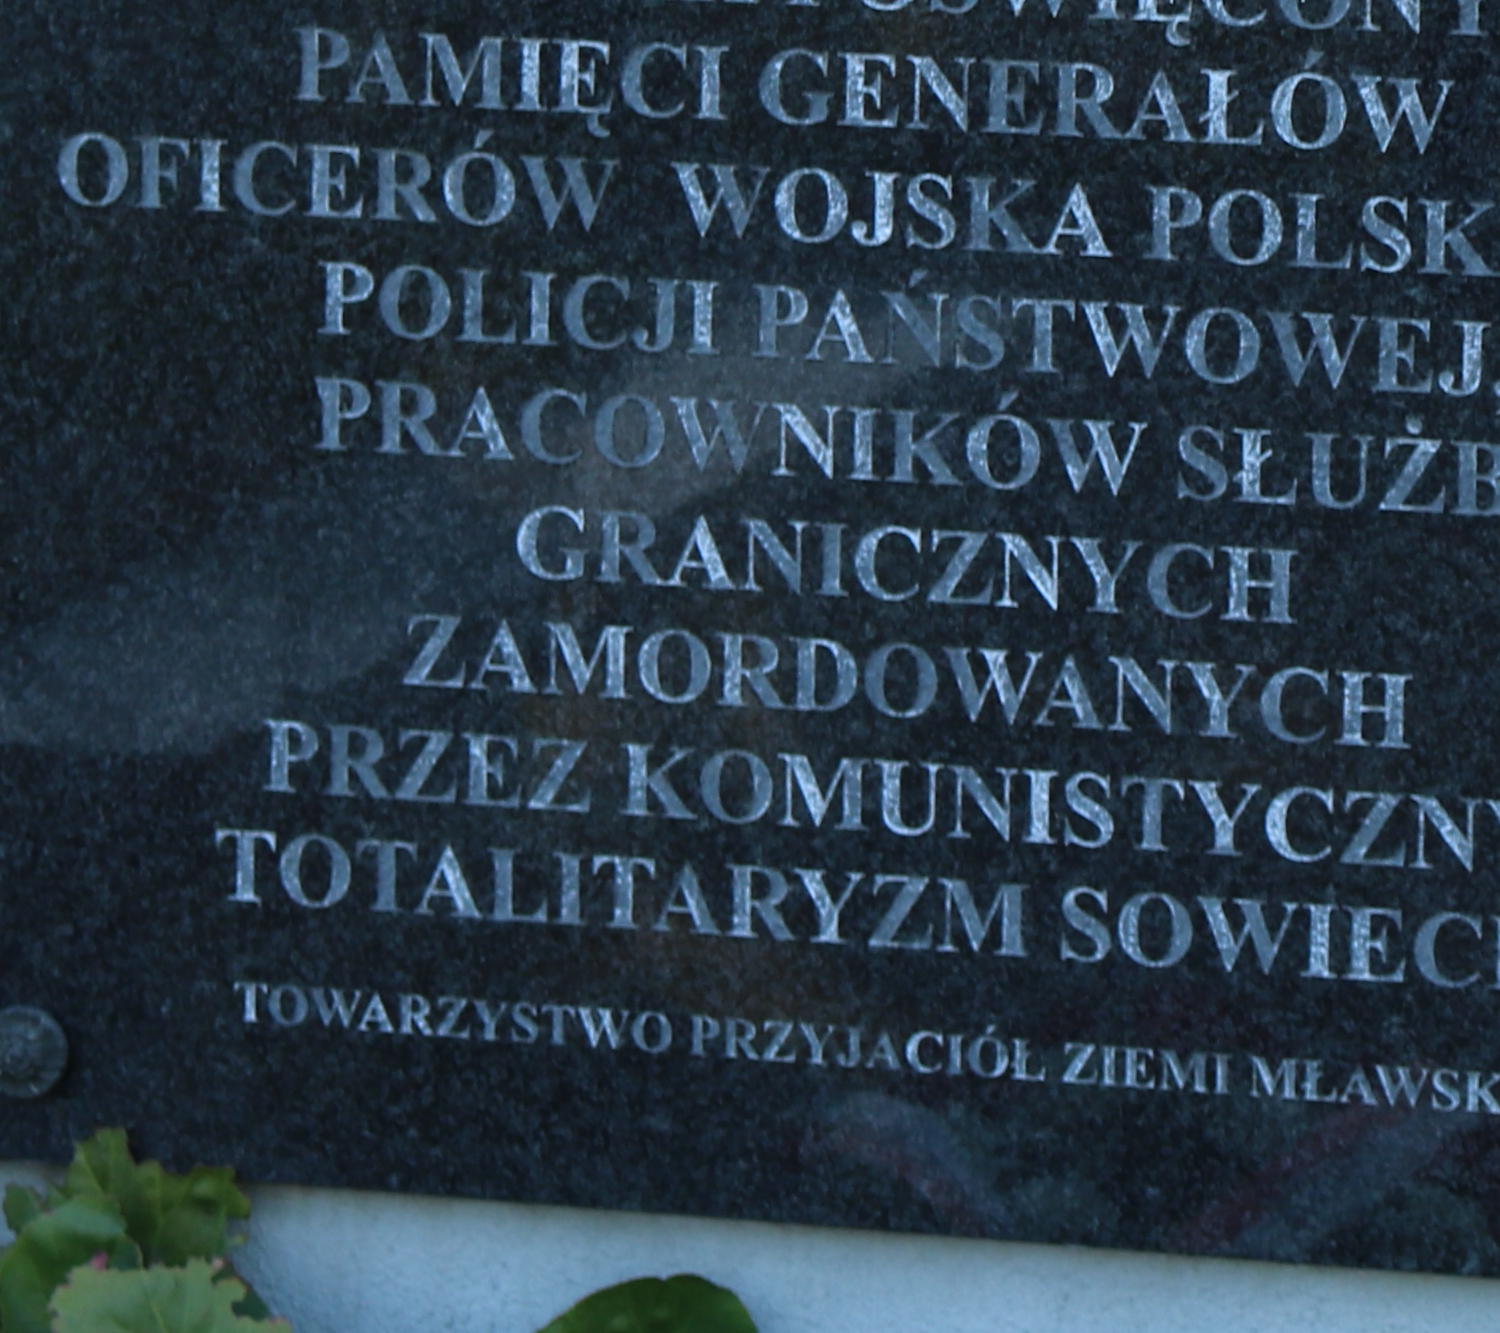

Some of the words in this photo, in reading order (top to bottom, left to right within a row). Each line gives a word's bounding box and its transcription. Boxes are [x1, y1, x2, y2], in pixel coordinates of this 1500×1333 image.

[296, 26, 731, 137] PAMIĘCI
[759, 48, 1455, 155] GENERAŁÓW
[57, 131, 619, 232] OFICERÓW
[671, 159, 1113, 258] WOJSKA
[317, 260, 720, 354] POLICJI
[313, 375, 1148, 497] PRACOWNIKÓW
[515, 505, 1300, 625] GRANICZNYCH
[402, 613, 1413, 749] ZAMORDOWANYCH
[262, 718, 591, 813] PRZEZ
[215, 827, 1027, 959] TOTALITARYZM
[234, 980, 672, 1055] TOWARZYSTWO
[690, 1015, 1047, 1084] PRZYJACIÓŁ
[1061, 1040, 1232, 1096] ZIEMI
